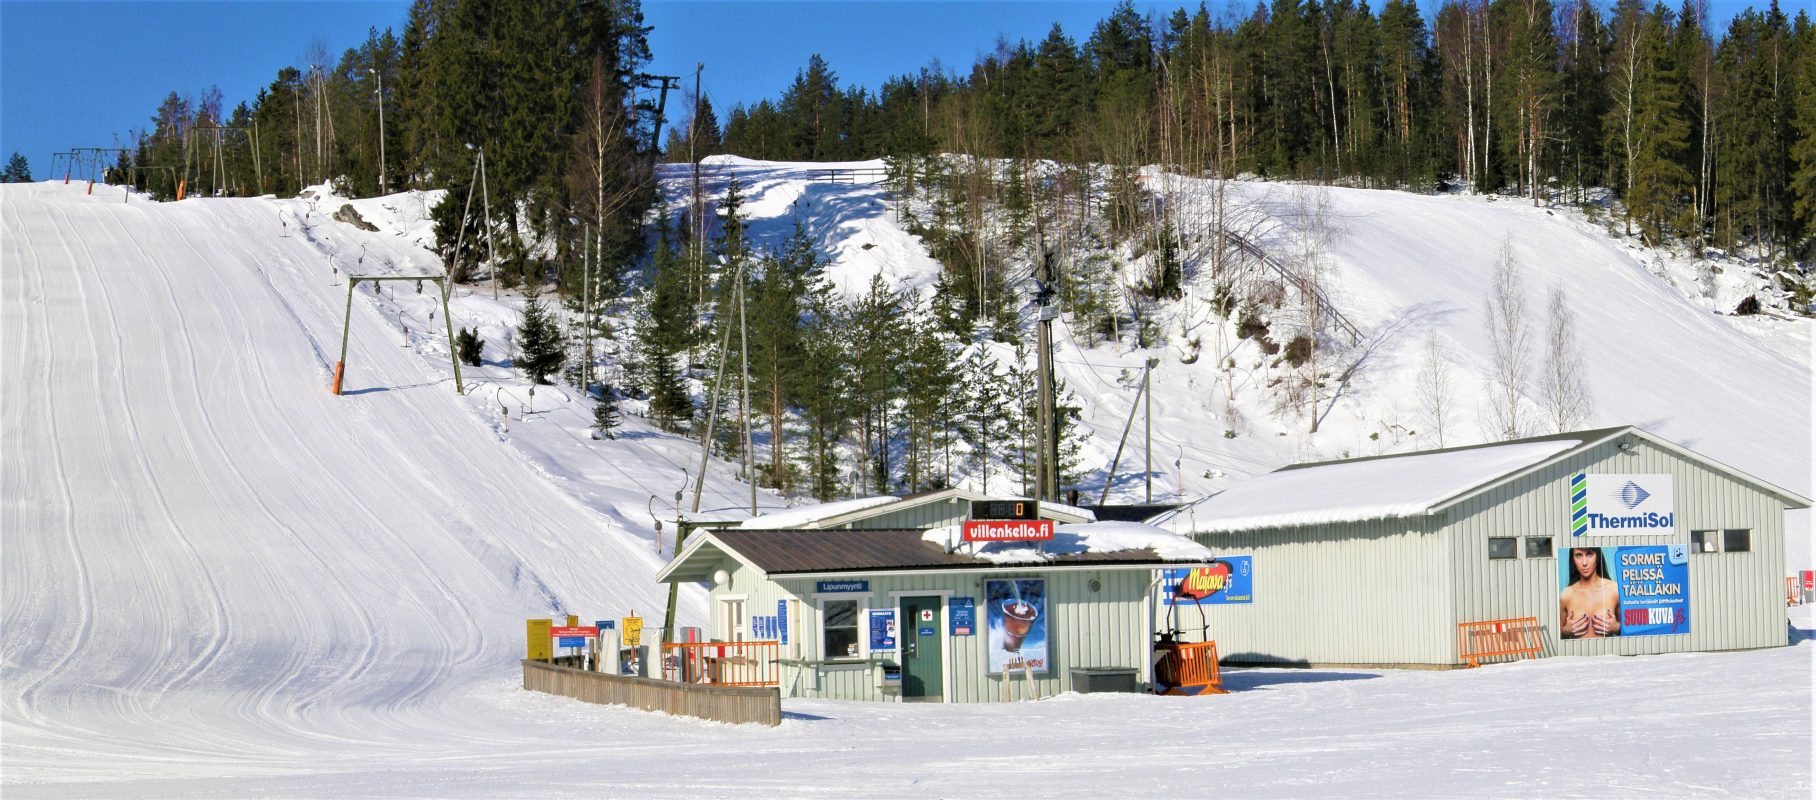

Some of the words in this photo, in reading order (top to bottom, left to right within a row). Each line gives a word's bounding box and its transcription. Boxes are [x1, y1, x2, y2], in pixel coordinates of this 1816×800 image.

[1015, 503, 1023, 515] 0
[1588, 512, 1674, 529] ThermiSol
[970, 523, 1049, 539] villenkello.fi
[1621, 552, 1666, 566] SORMET
[1189, 568, 1233, 593] Majava.fi
[1622, 566, 1665, 581] PELISSÄ
[822, 582, 863, 592] Lipunmyynti
[1623, 581, 1681, 597] TÄÄLLÄKIN
